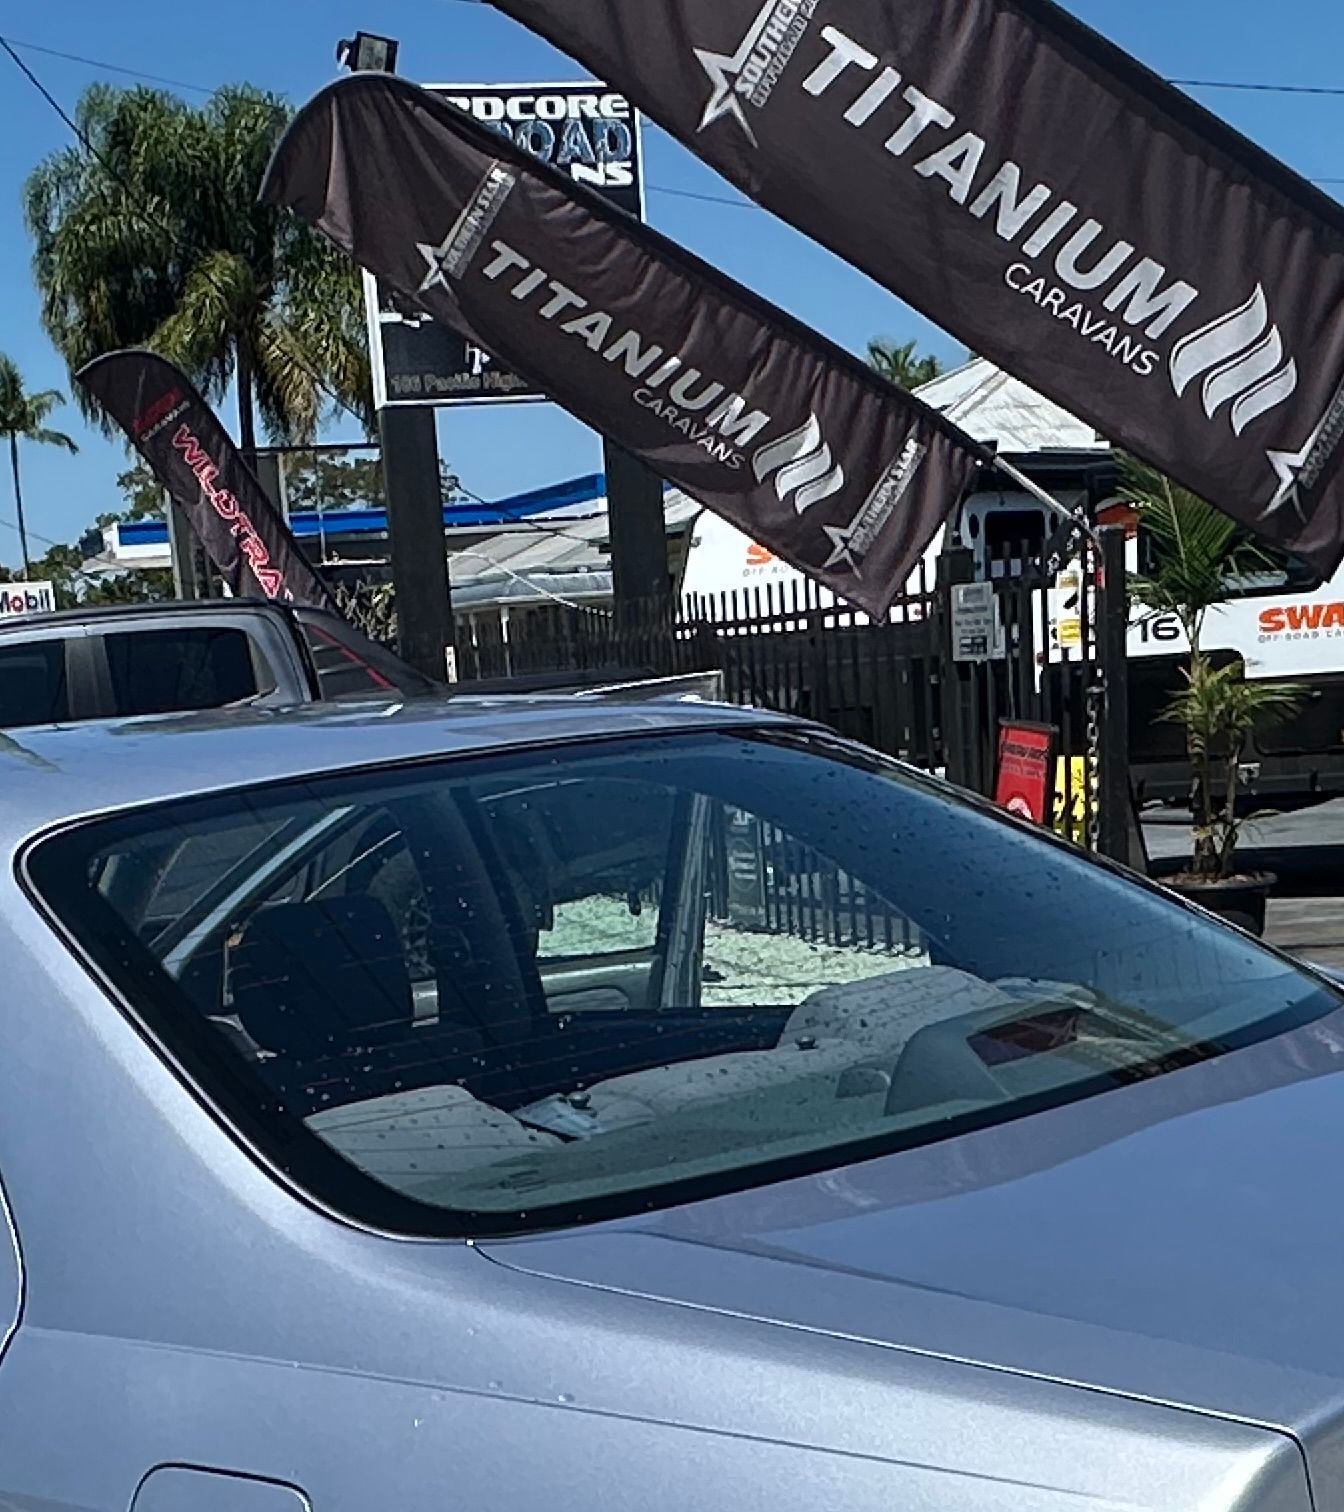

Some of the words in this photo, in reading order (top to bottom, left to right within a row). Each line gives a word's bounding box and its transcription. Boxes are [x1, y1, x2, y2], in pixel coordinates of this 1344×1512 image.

[802, 25, 1199, 341] TITANIUM
[482, 239, 772, 448] TITANIUM
[1004, 262, 1160, 377] CARAVANS
[172, 422, 294, 602] WILDTRA
[632, 388, 746, 470] CARAVANS
